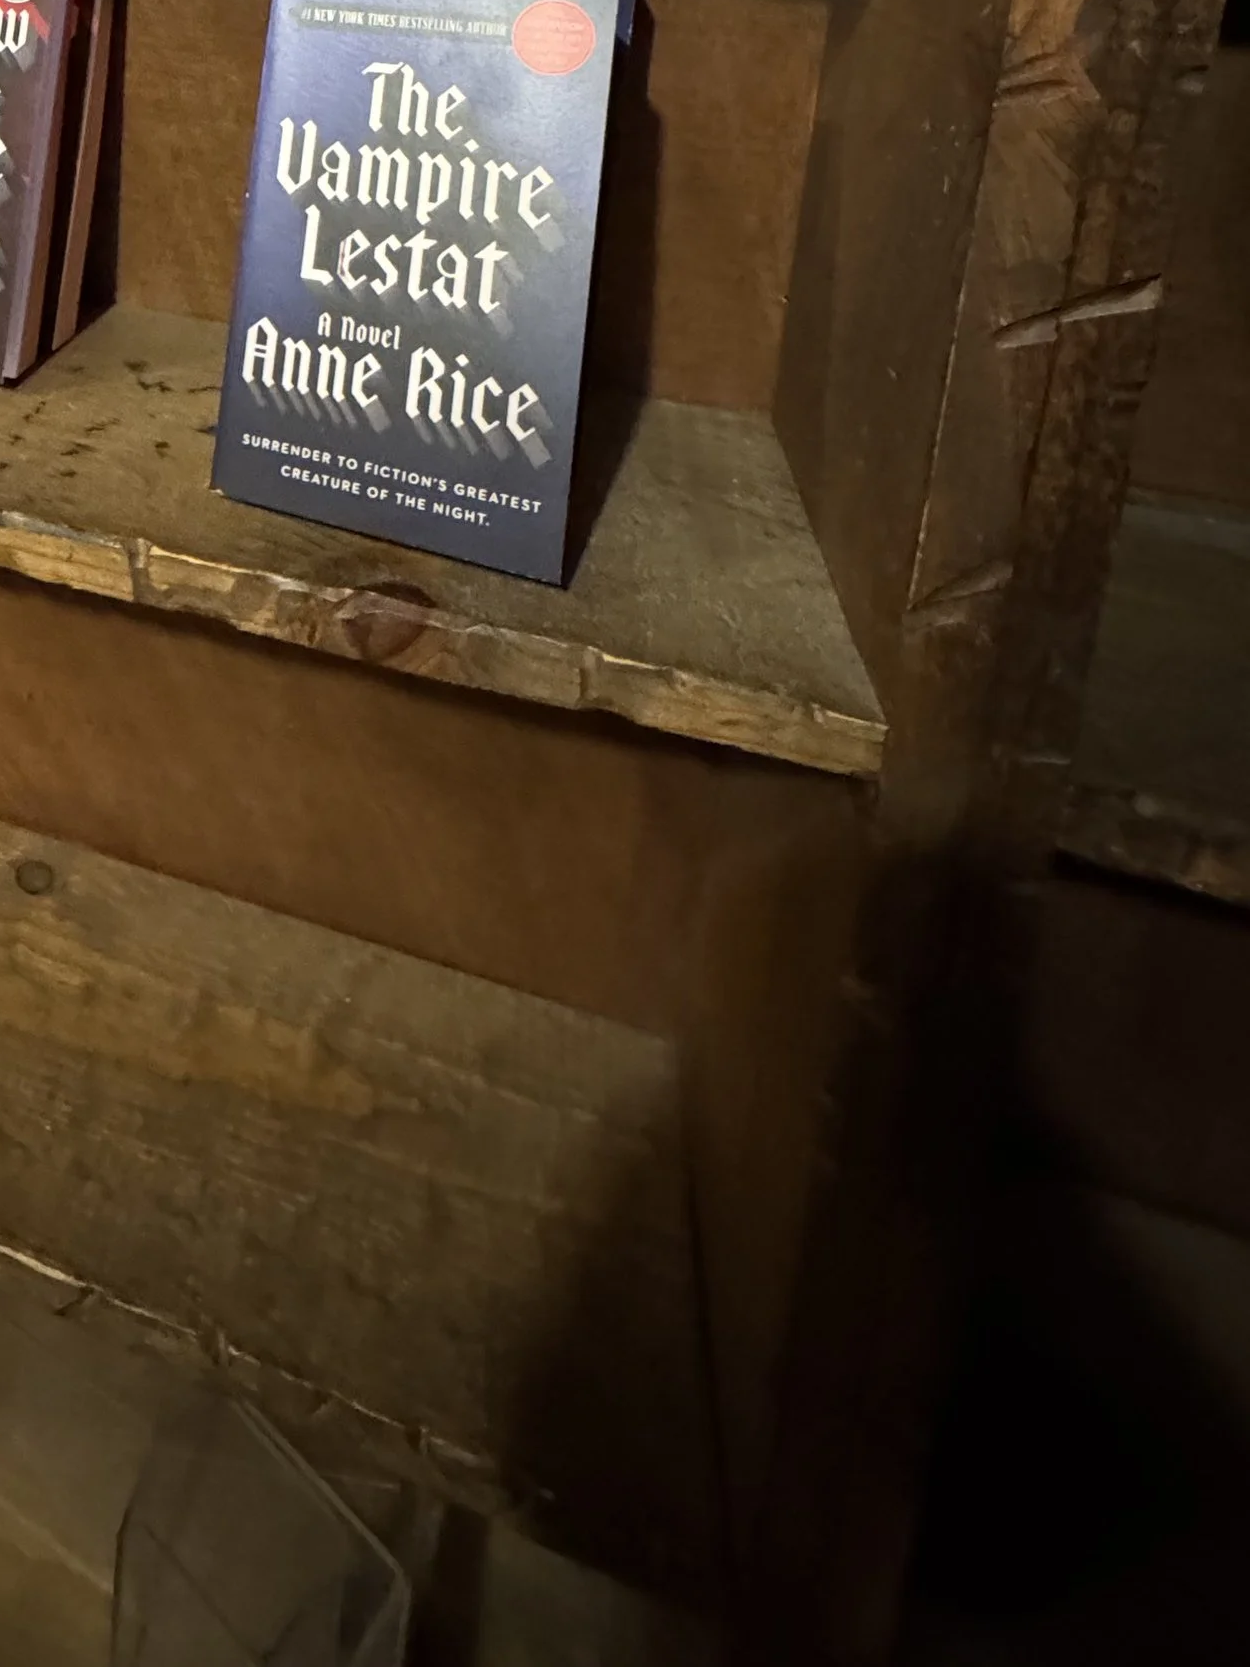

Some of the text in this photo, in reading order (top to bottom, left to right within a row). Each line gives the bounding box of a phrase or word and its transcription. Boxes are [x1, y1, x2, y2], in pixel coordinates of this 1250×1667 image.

[301, 7, 508, 36] #1 NEW YORK TIMES BESTSELLING AUTHOR
[361, 61, 467, 140] The
[275, 116, 555, 231] Vampire
[300, 203, 509, 315] Lestat
[317, 311, 401, 350] A Novel
[241, 316, 540, 442] Anne Rice
[242, 432, 542, 514] SURRENDER TO FICTION'S GREATEST
[280, 464, 491, 527] CREATURE OF THE NIGHT.
